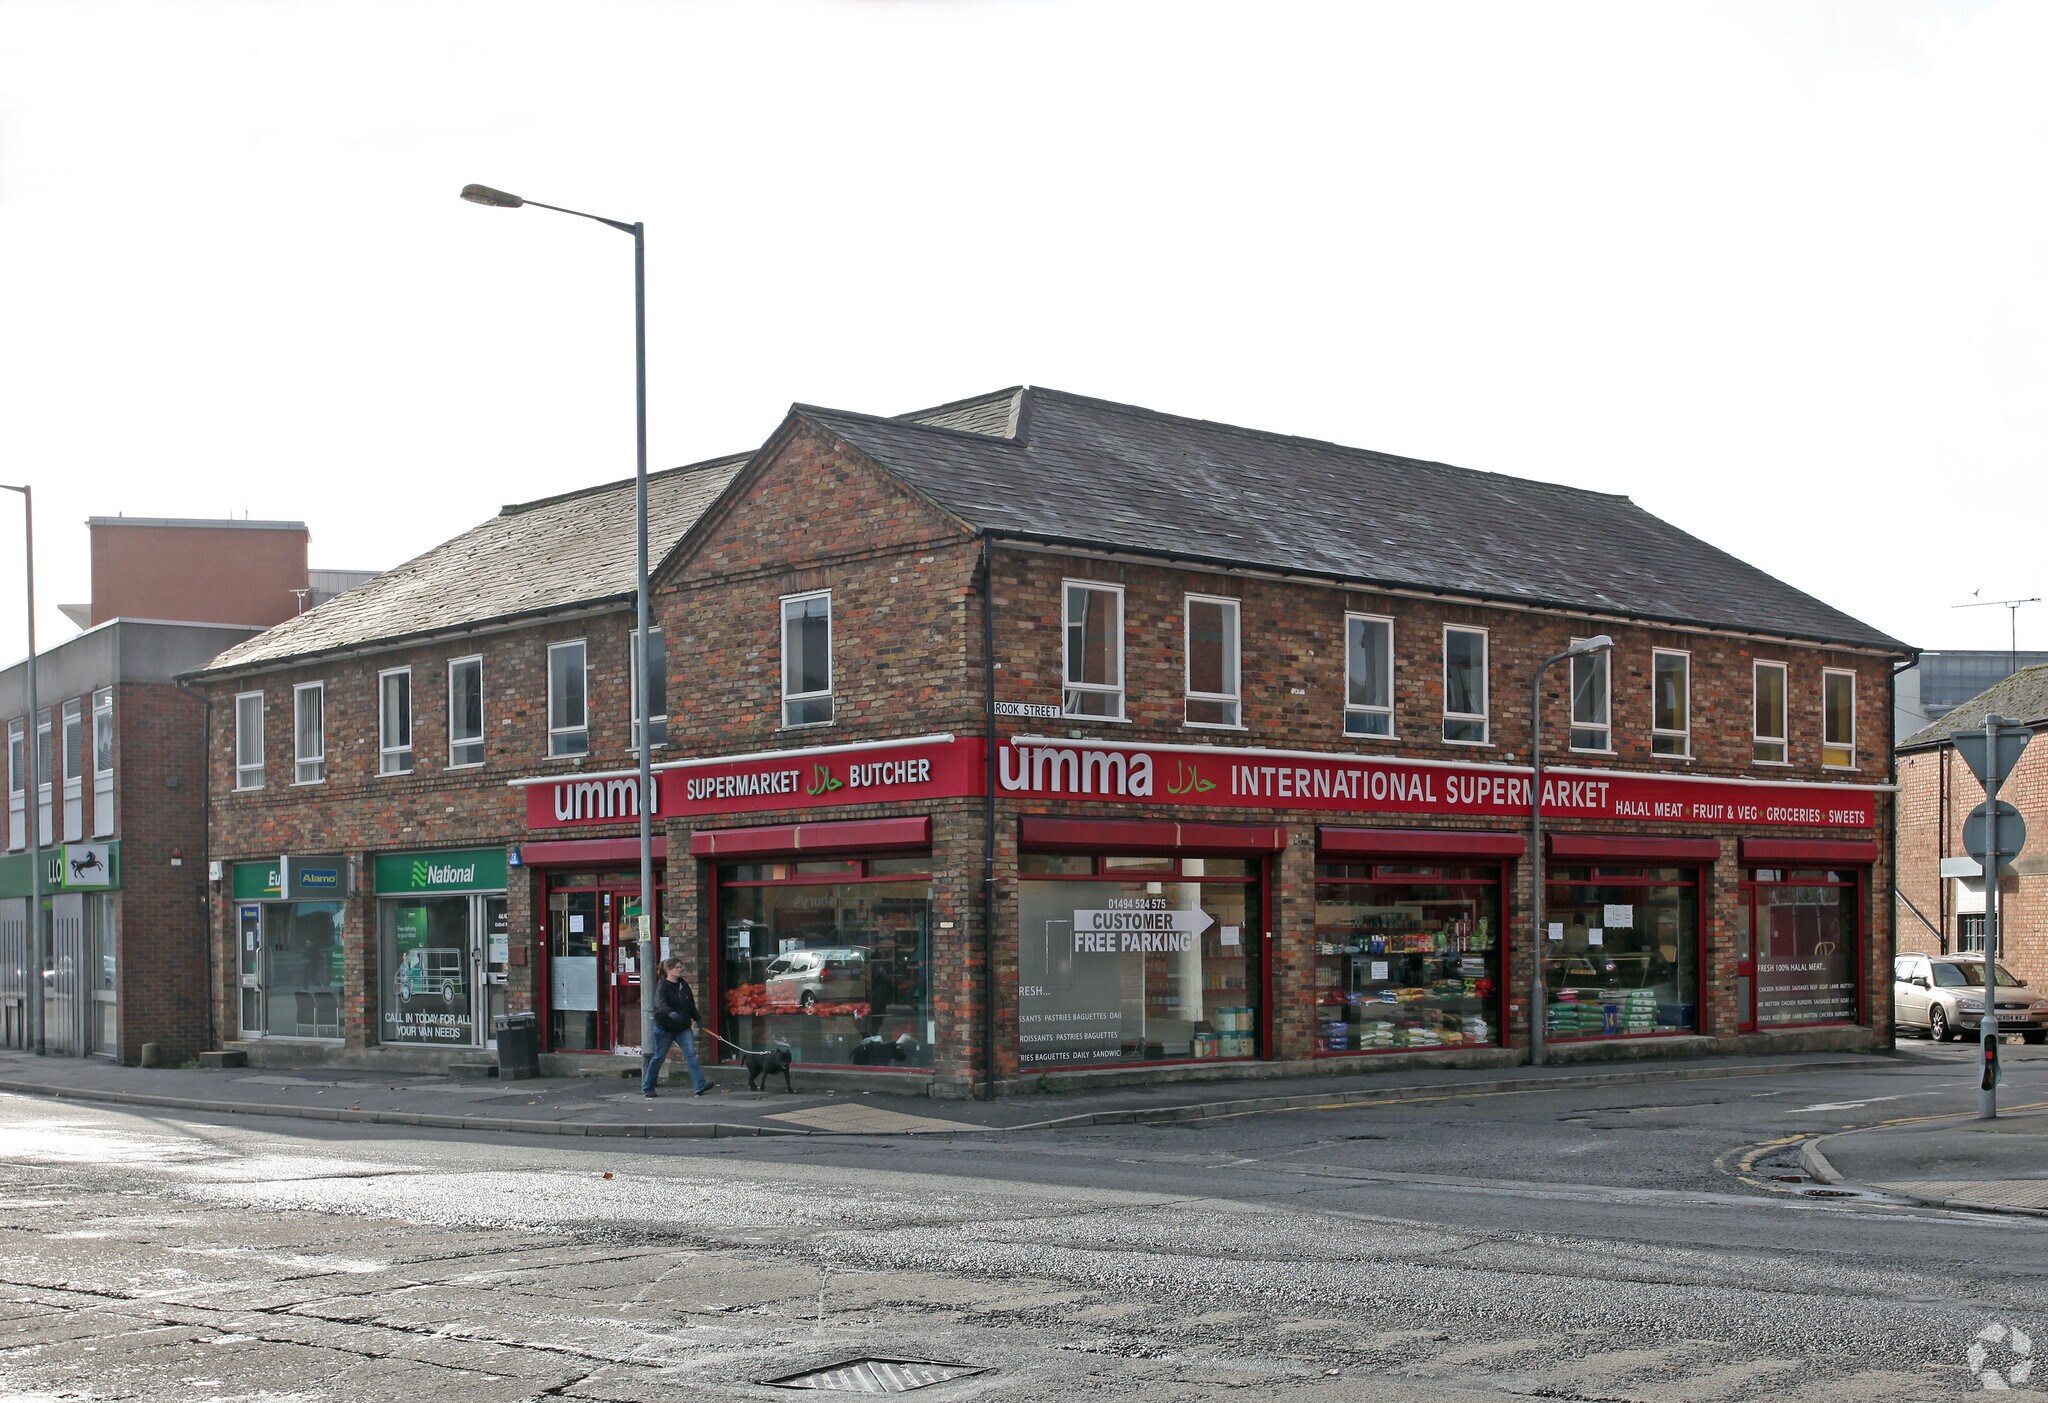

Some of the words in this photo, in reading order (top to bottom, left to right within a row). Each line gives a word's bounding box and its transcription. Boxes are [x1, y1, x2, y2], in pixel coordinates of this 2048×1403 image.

[993, 703, 1019, 714] ROOK
[1024, 705, 1057, 717] STREET
[806, 763, 843, 795] حلال
[849, 758, 930, 788] BUTCHER
[999, 746, 1153, 797] umma
[1167, 760, 1217, 794] حلال
[686, 770, 799, 800] SUPERMARKET
[1231, 765, 1437, 802] INTERNATIONAL
[1446, 775, 1609, 808] SUPERMARKET
[1615, 800, 1651, 816] HALAL
[1654, 802, 1683, 817] MEAT
[1693, 804, 1724, 819] FRUIT
[1727, 805, 1734, 819] &
[1737, 805, 1758, 820] VEG
[1766, 806, 1820, 822] GROCERIES
[1828, 809, 1865, 824] SWEETS
[302, 874, 336, 883] Alamo
[427, 864, 475, 884] National
[1108, 899, 1133, 909] 01494
[1135, 899, 1150, 909] 524
[1151, 899, 1167, 909] 575
[1092, 912, 1173, 929] CUSTOMER
[1074, 933, 1116, 952] FREE
[1121, 932, 1192, 952] PARKING
[1757, 964, 1774, 972] FRESH
[1775, 964, 1789, 972] 100%
[1790, 963, 1807, 971] HALAL
[385, 1012, 404, 1023] CALL
[405, 1013, 413, 1023] IN
[415, 1013, 438, 1023] TODAY
[440, 1014, 456, 1024] FOR
[457, 1015, 472, 1025] ALL
[1044, 1013, 1072, 1022] PASTRIES
[1072, 1012, 1107, 1021] BAGUETTES
[396, 1026, 416, 1036] YOUR
[418, 1026, 433, 1037] VAN
[434, 1027, 460, 1038] NEEDS
[1056, 1032, 1083, 1041] PASTRIES
[1084, 1031, 1118, 1040] BAGUETTES
[1035, 1052, 1070, 1061] BAGUETTES
[1072, 1051, 1090, 1059] DAILY
